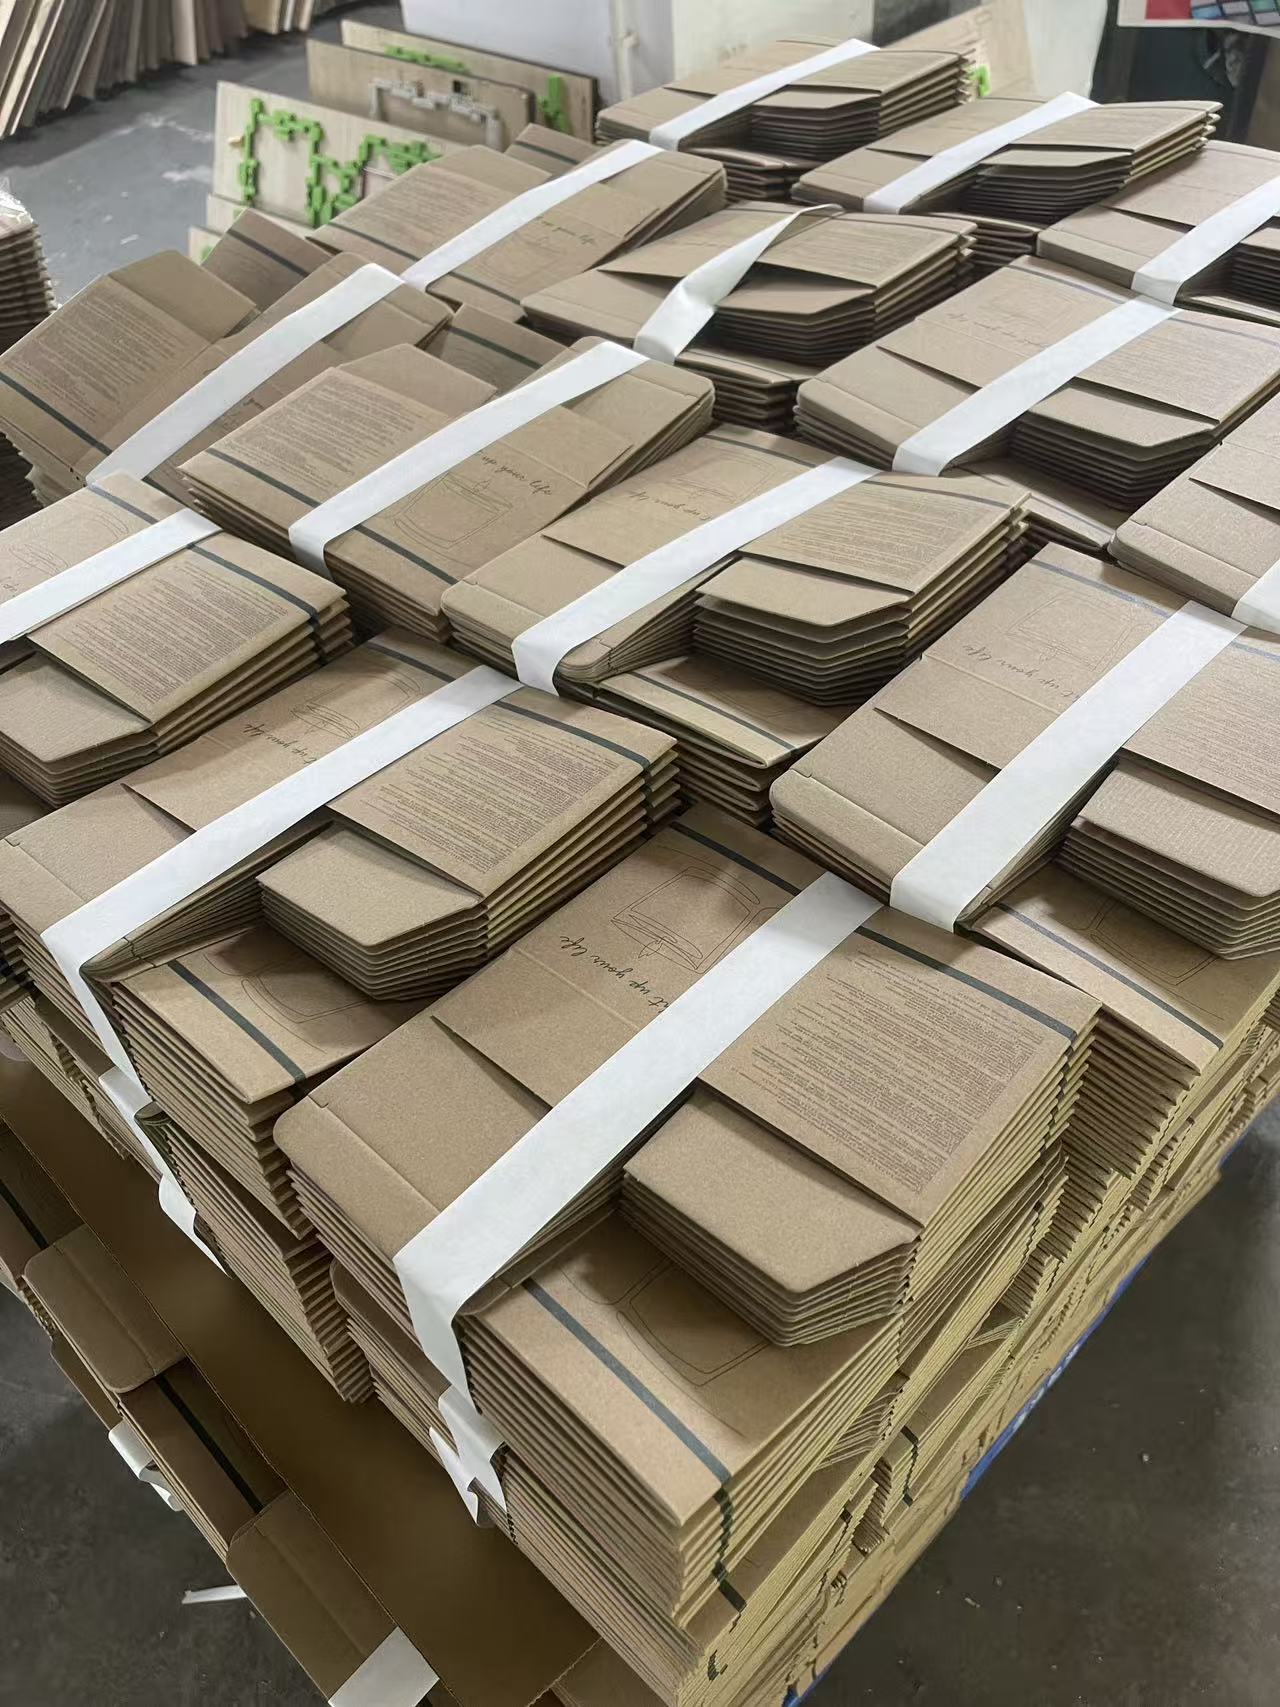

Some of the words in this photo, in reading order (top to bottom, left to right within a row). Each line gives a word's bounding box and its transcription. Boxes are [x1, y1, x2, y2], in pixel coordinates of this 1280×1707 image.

[528, 480, 552, 495] life
[962, 645, 992, 661] life
[559, 935, 588, 957] life
[590, 954, 634, 979] your
[628, 980, 651, 995] up
